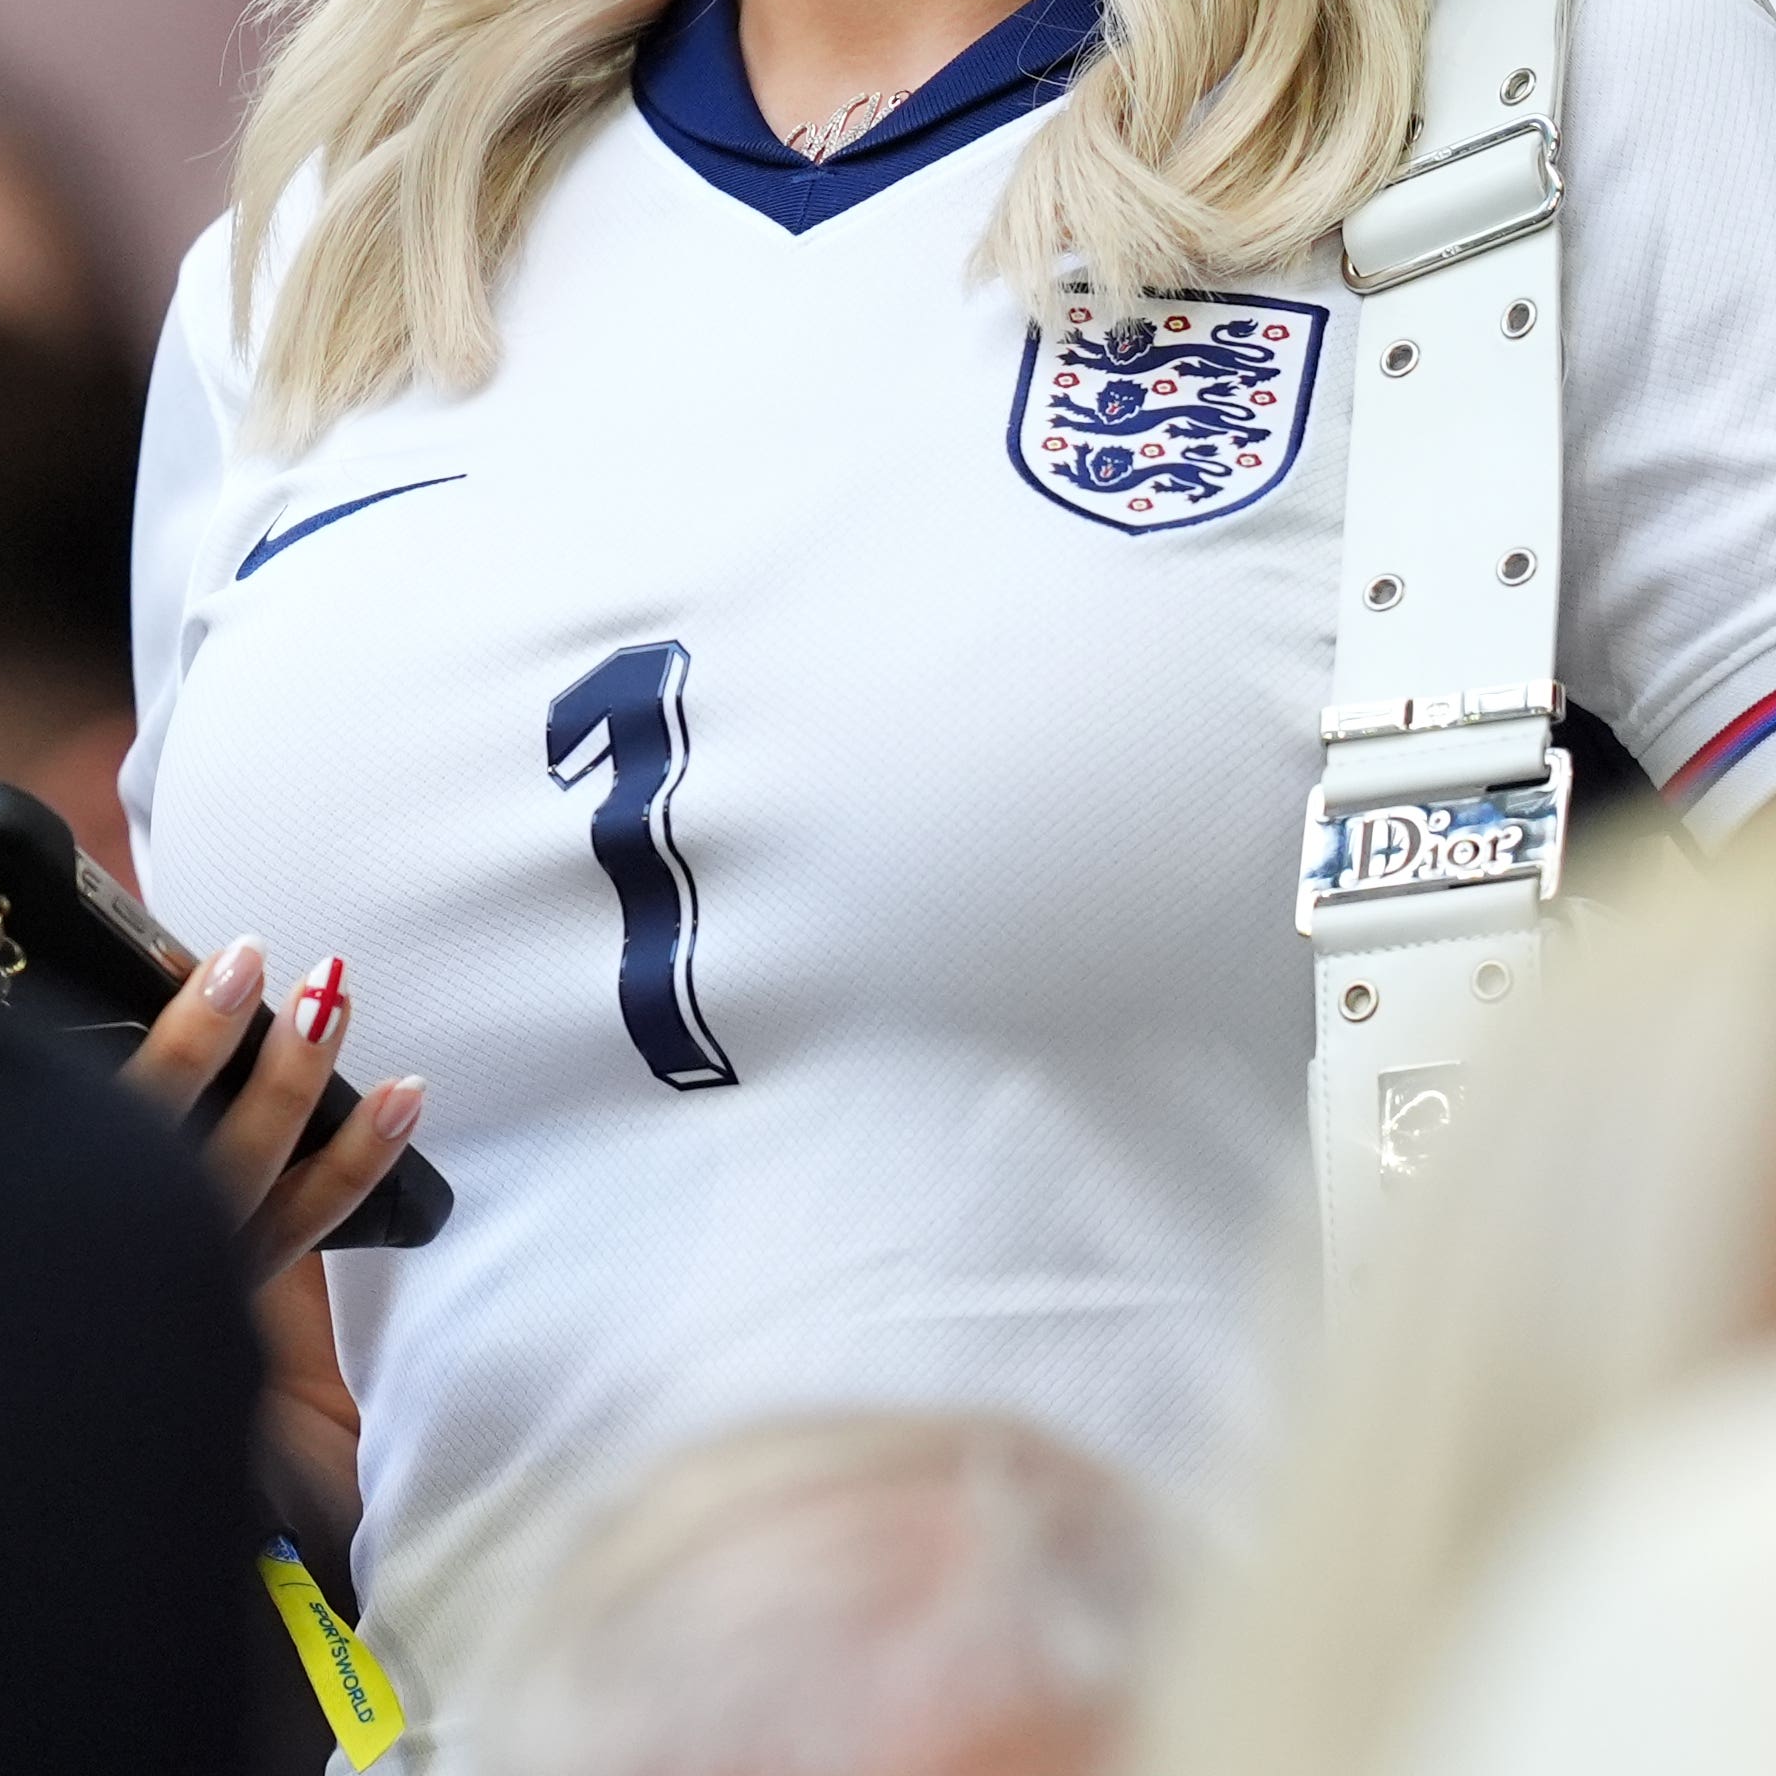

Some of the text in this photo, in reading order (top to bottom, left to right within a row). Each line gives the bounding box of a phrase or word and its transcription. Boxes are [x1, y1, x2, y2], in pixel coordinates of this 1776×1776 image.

[546, 639, 740, 1091] 1
[1341, 806, 1522, 886] Dior
[309, 1602, 373, 1723] SPORTSWORLD
